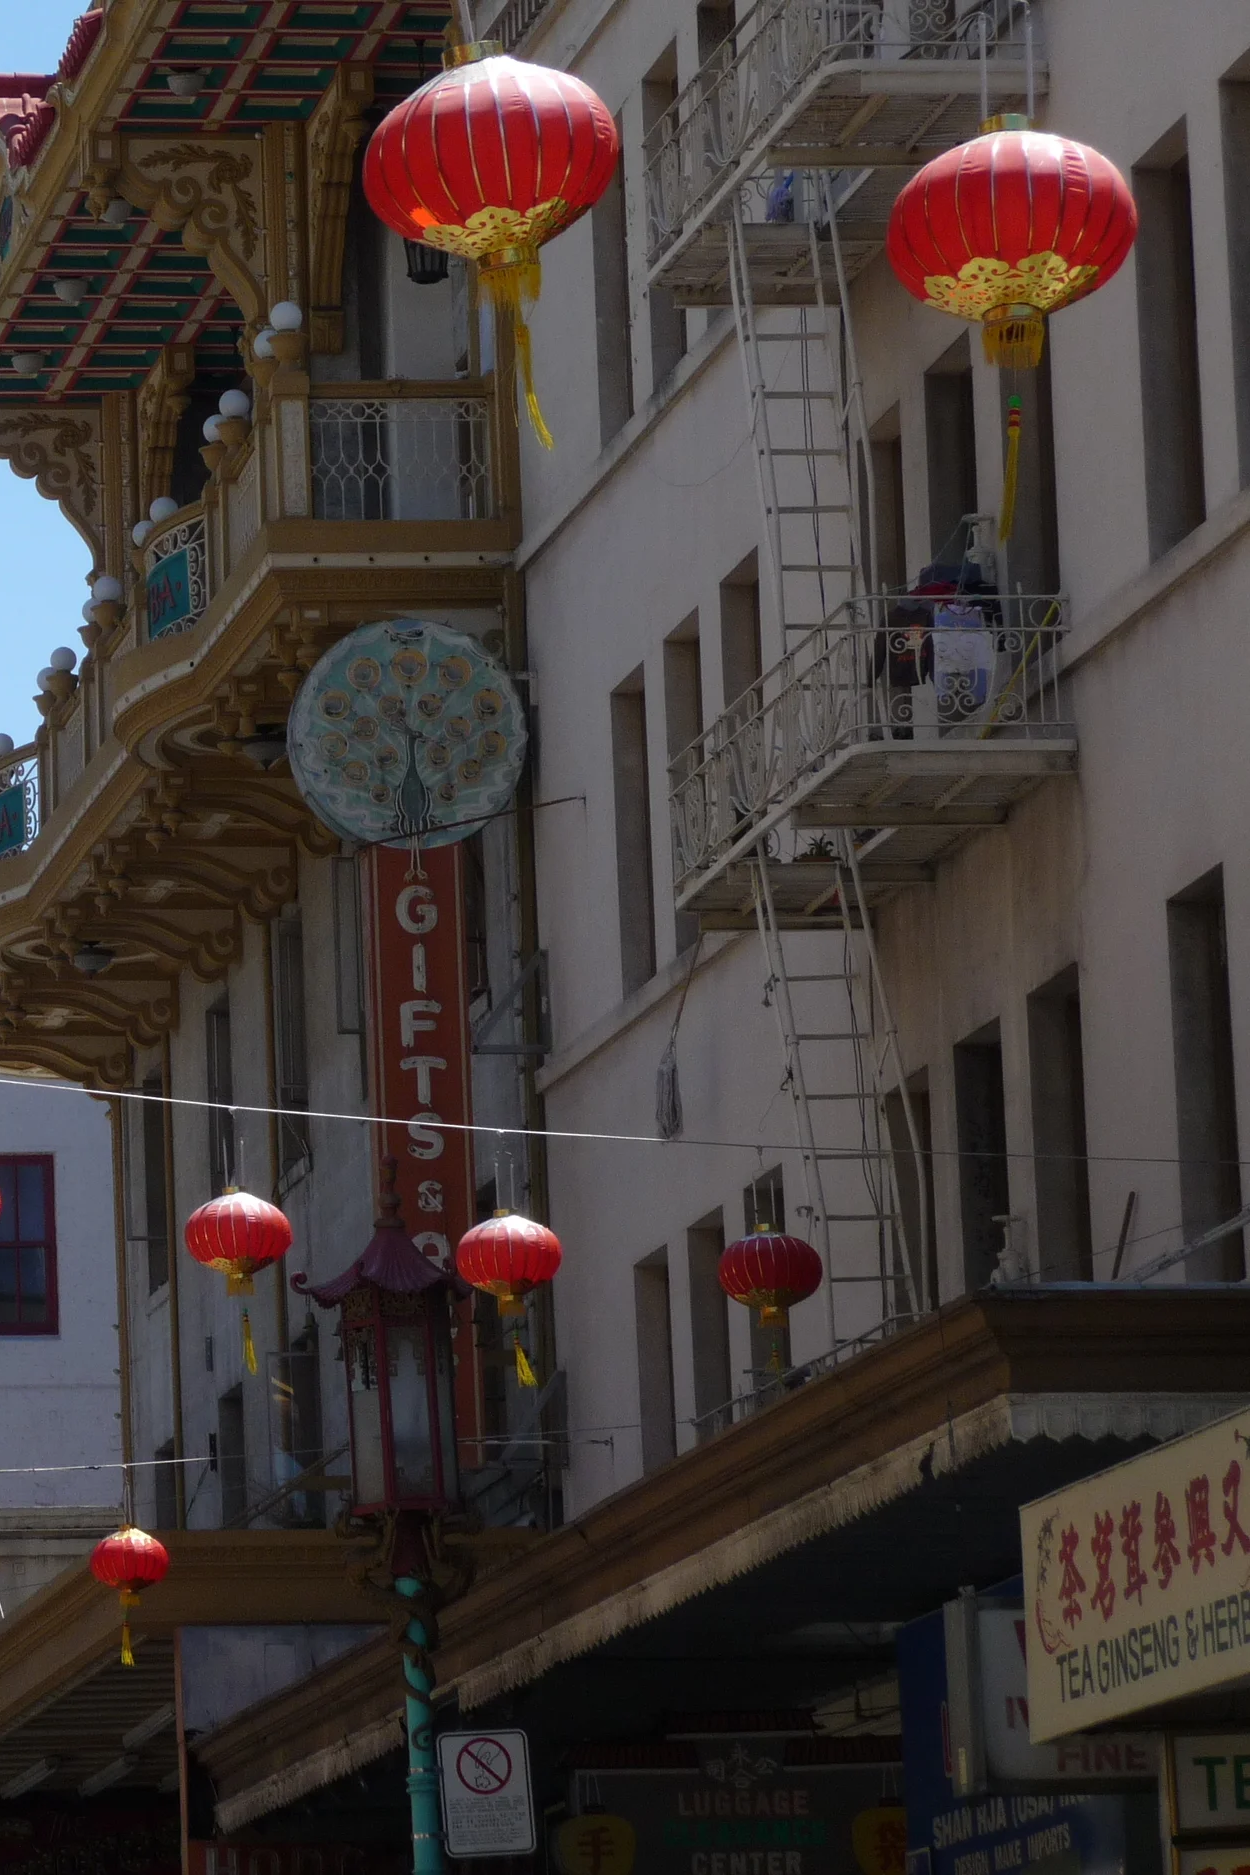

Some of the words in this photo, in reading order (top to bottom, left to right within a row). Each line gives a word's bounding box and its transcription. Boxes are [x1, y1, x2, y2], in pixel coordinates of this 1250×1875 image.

[394, 884, 448, 1161] GIFTS
[417, 1179, 444, 1213] &
[1056, 1644, 1096, 1703] TEA
[1096, 1614, 1180, 1695] GINSENG
[1185, 1609, 1201, 1660] &
[1057, 1743, 1147, 1771] FINE
[678, 1789, 810, 1816] LUGGAGE
[932, 1806, 972, 1850] SHAN
[994, 1838, 1022, 1871] MAKE
[1026, 1821, 1071, 1862] IMPORTS
[691, 1849, 801, 1875] CENTER
